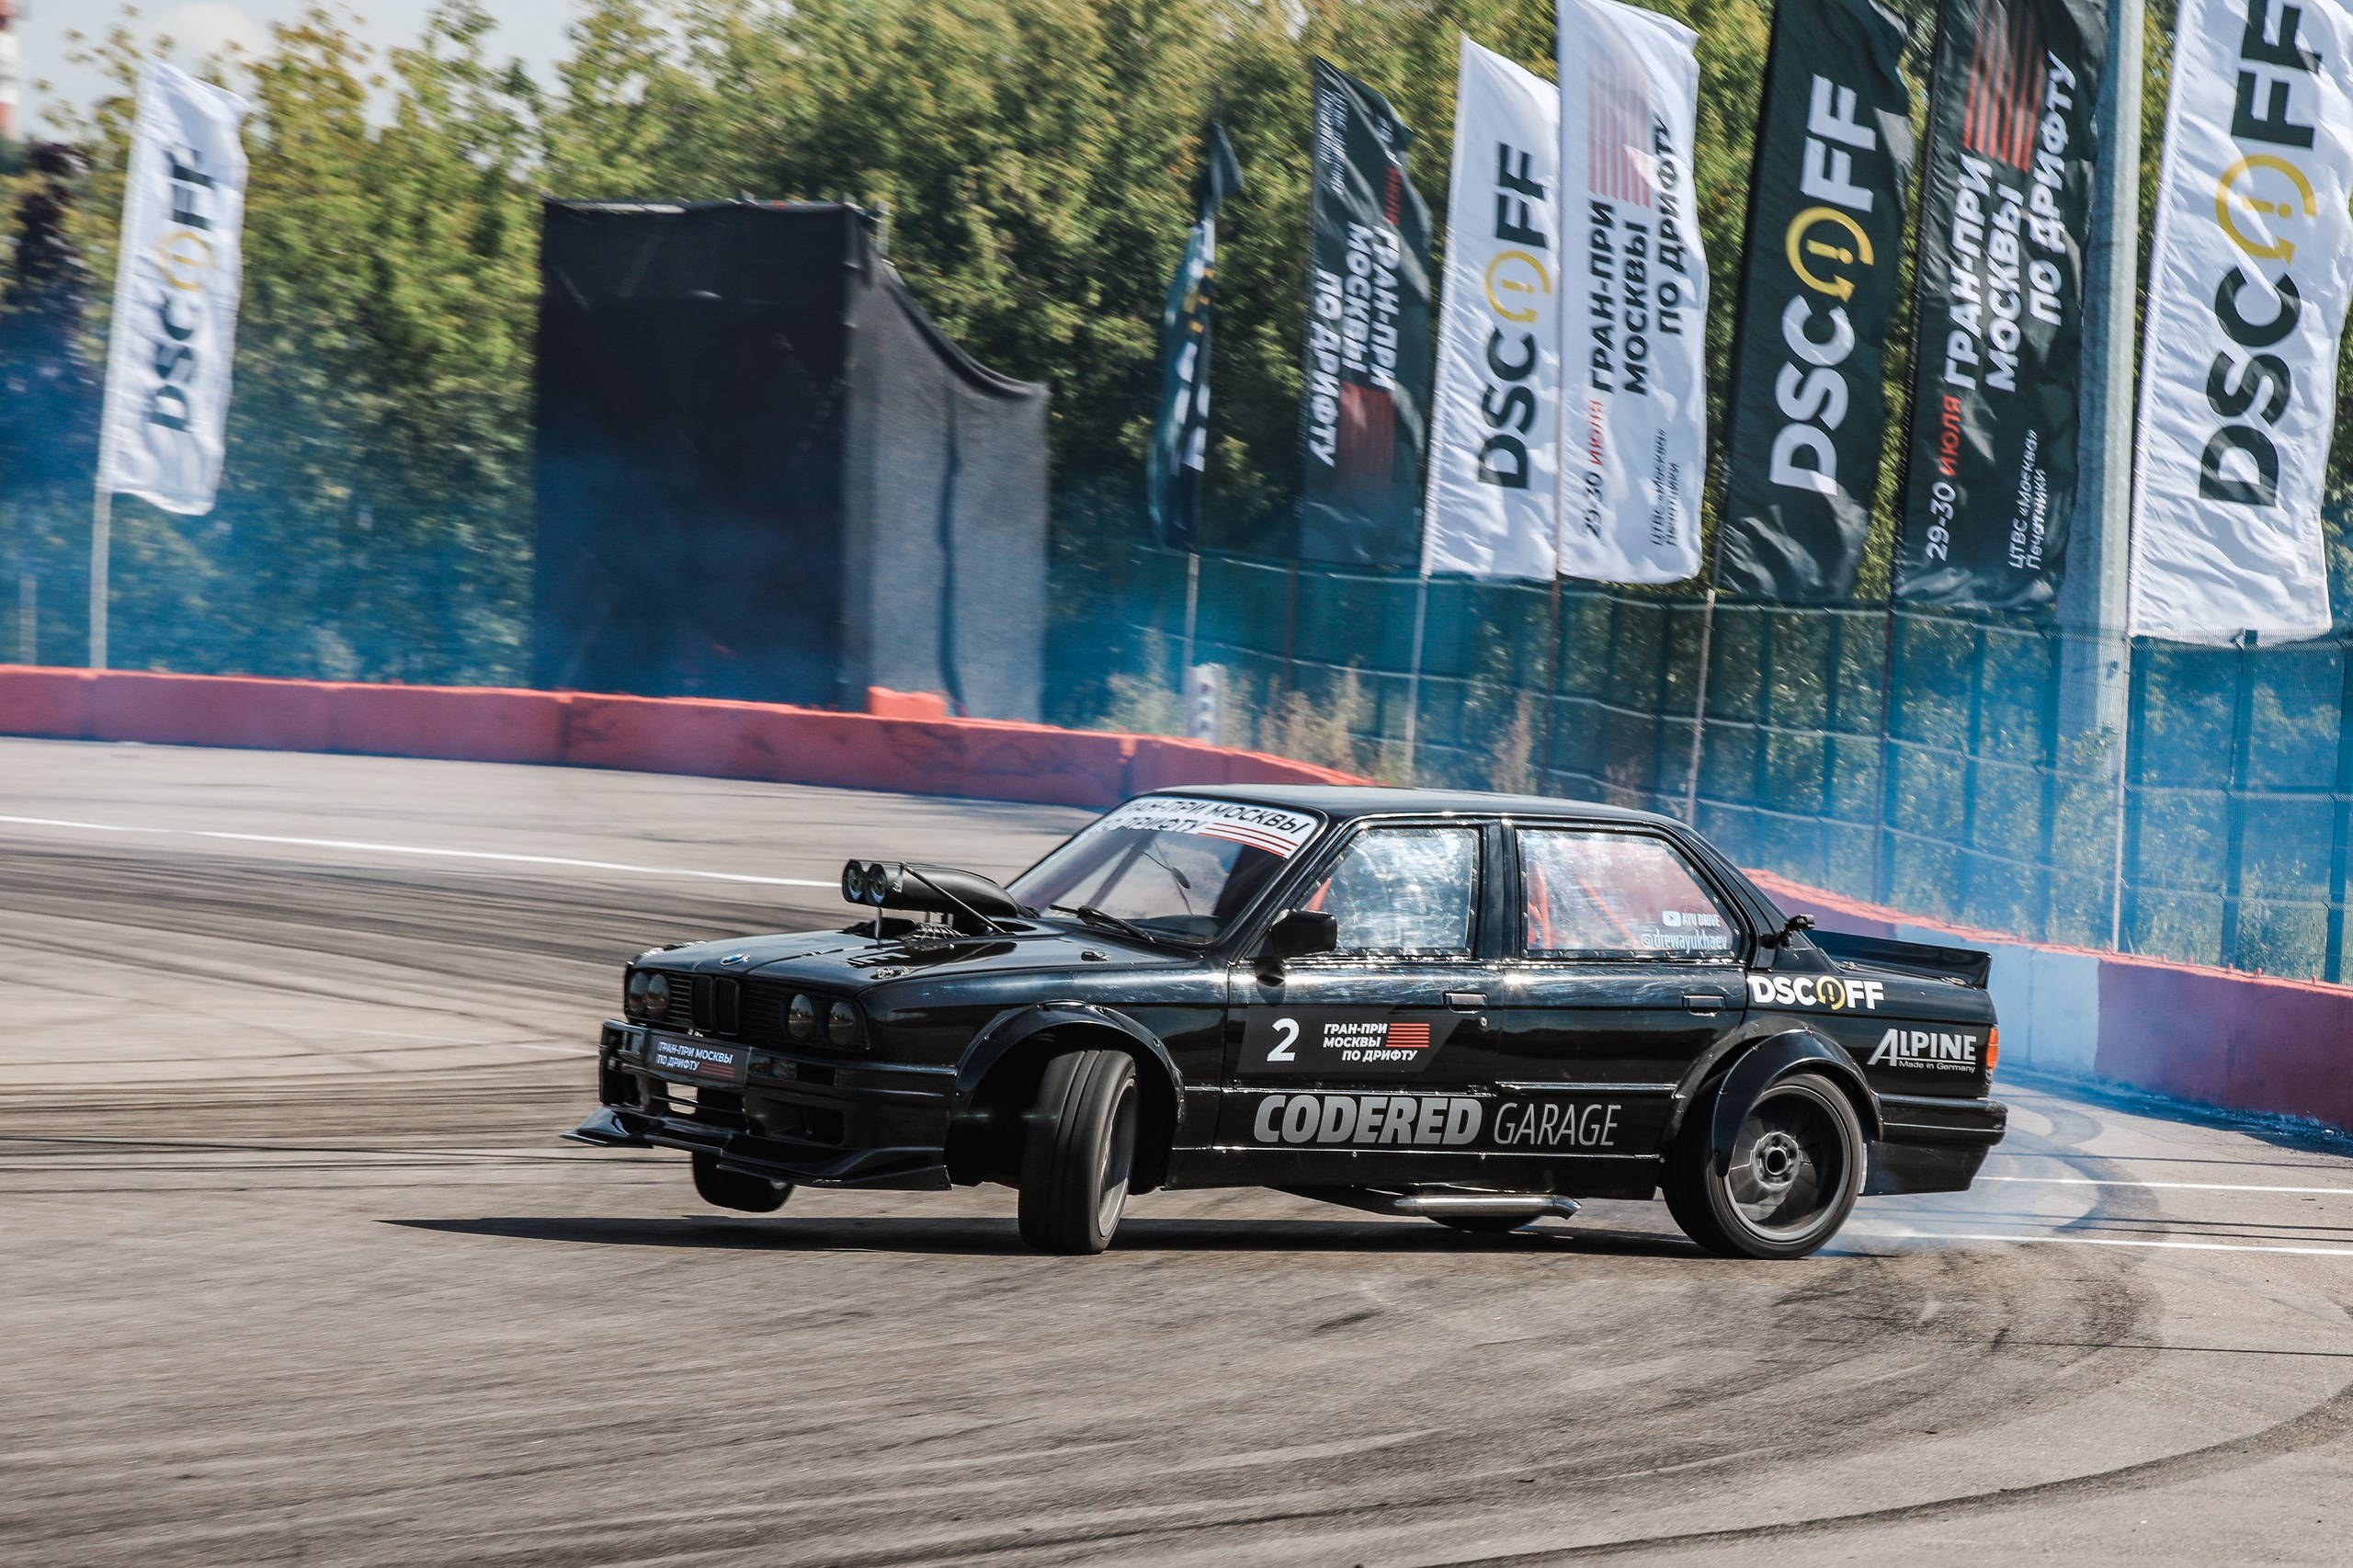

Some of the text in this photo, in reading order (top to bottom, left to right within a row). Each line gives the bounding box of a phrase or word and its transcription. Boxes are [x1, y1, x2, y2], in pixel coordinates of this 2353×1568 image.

[2029, 49, 2076, 326] ПО ДРИФТУ
[1654, 116, 1687, 336] ПО ДРИФТУ
[1588, 198, 1616, 394] ГРАН-ПРИ
[1944, 153, 1993, 390] ГРАН-ПРИ
[1984, 183, 2024, 392] МОСКВЫ
[1342, 221, 1373, 374] МОСКВЫ
[1370, 224, 1400, 392] ГРАН-ПРИ
[1622, 220, 1650, 396] МОСКВЫ
[1309, 267, 1343, 468] ПО ДРИФТУ
[1926, 482, 1956, 562] 29-30
[2007, 517, 2028, 569] ЦТВС
[1205, 802, 1312, 835] МОСКВЫ
[1682, 912, 1721, 926] AYU DRIVE
[657, 1040, 733, 1064] ГРАН-ПРИ МОСКВЫ
[1267, 1017, 1300, 1062] 2
[1323, 1037, 1381, 1048] МОСКВЫ
[1324, 1023, 1388, 1034] ГРАН-ПРИ
[1867, 1028, 1977, 1066] ALPINE
[655, 1053, 699, 1071] ПО ДРИФТУ
[1342, 1050, 1418, 1062] ПО ДРИФТУ
[1899, 1060, 1924, 1069] Made
[1937, 1062, 1975, 1074] Germany
[1254, 1095, 1621, 1146] CODERED GARAGE
